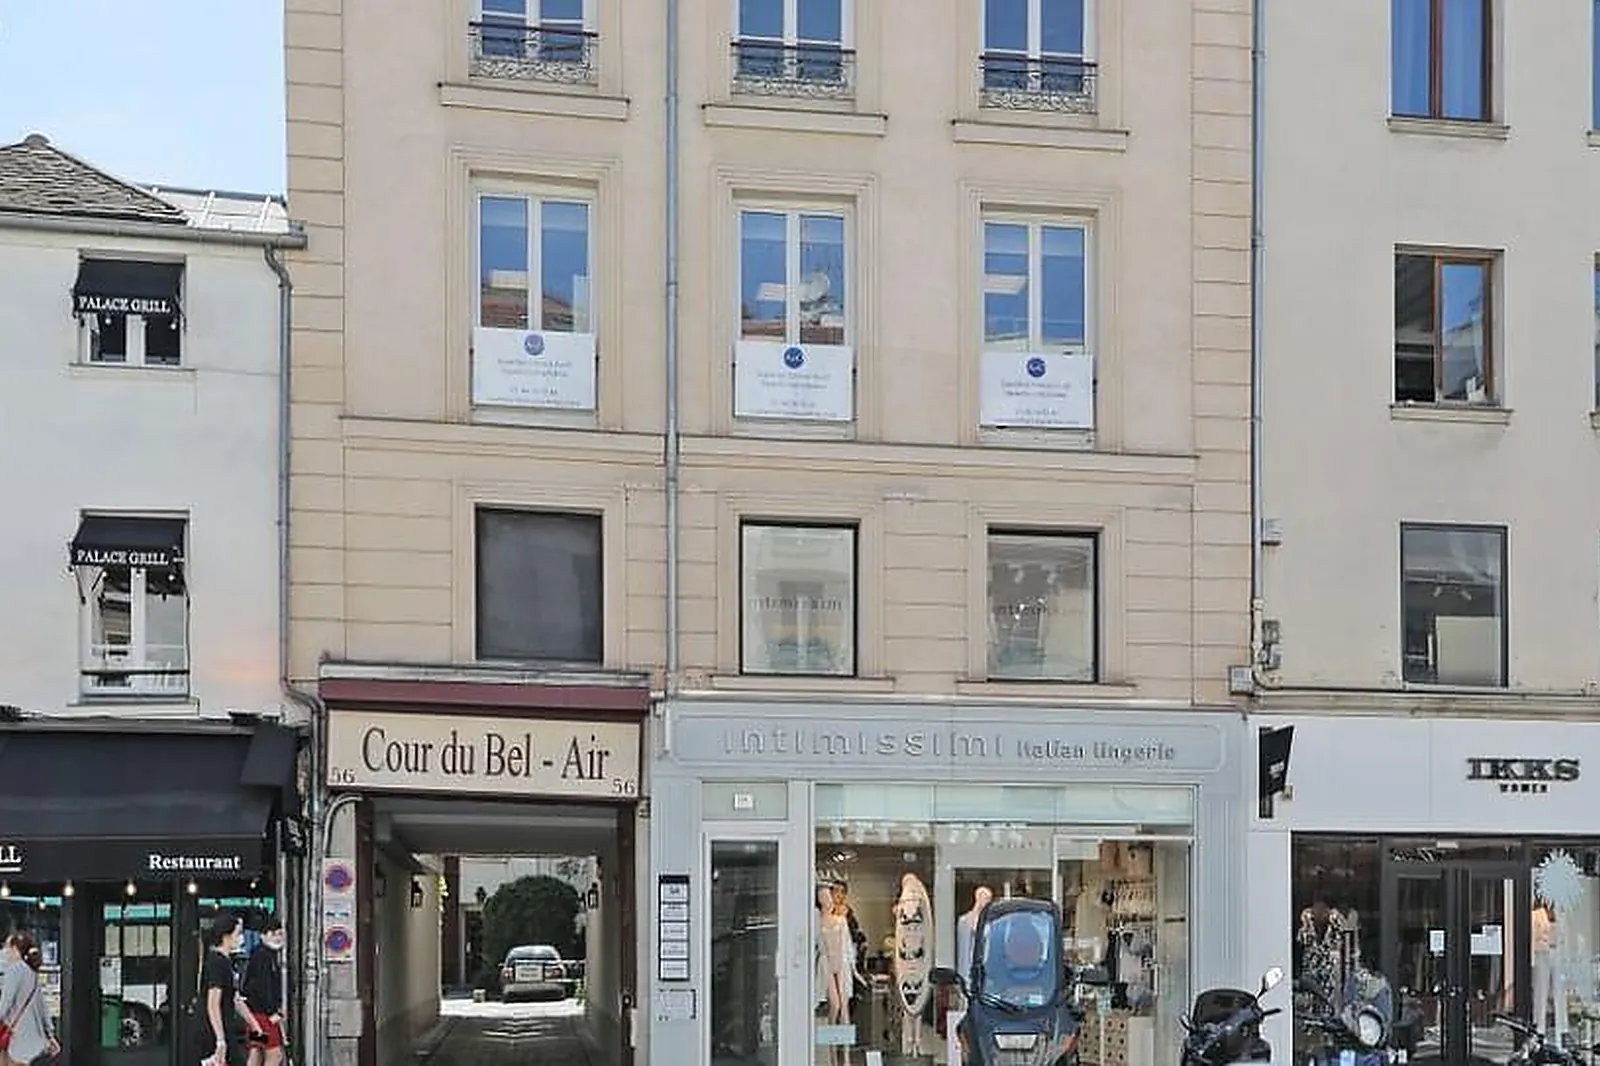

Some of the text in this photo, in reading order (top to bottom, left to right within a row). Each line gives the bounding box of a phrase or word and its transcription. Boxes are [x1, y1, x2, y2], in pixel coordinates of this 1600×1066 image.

[79, 296, 171, 313] PALACE GRILL
[77, 549, 169, 565] PALACE GRILL
[722, 728, 1005, 758] intimissimi
[361, 727, 433, 773] Cour
[441, 730, 476, 775] du
[484, 733, 532, 778] Bel
[561, 734, 611, 780] Air
[1466, 758, 1580, 781] IKKS
[611, 778, 635, 794] 56
[149, 853, 242, 870] Restaurant
